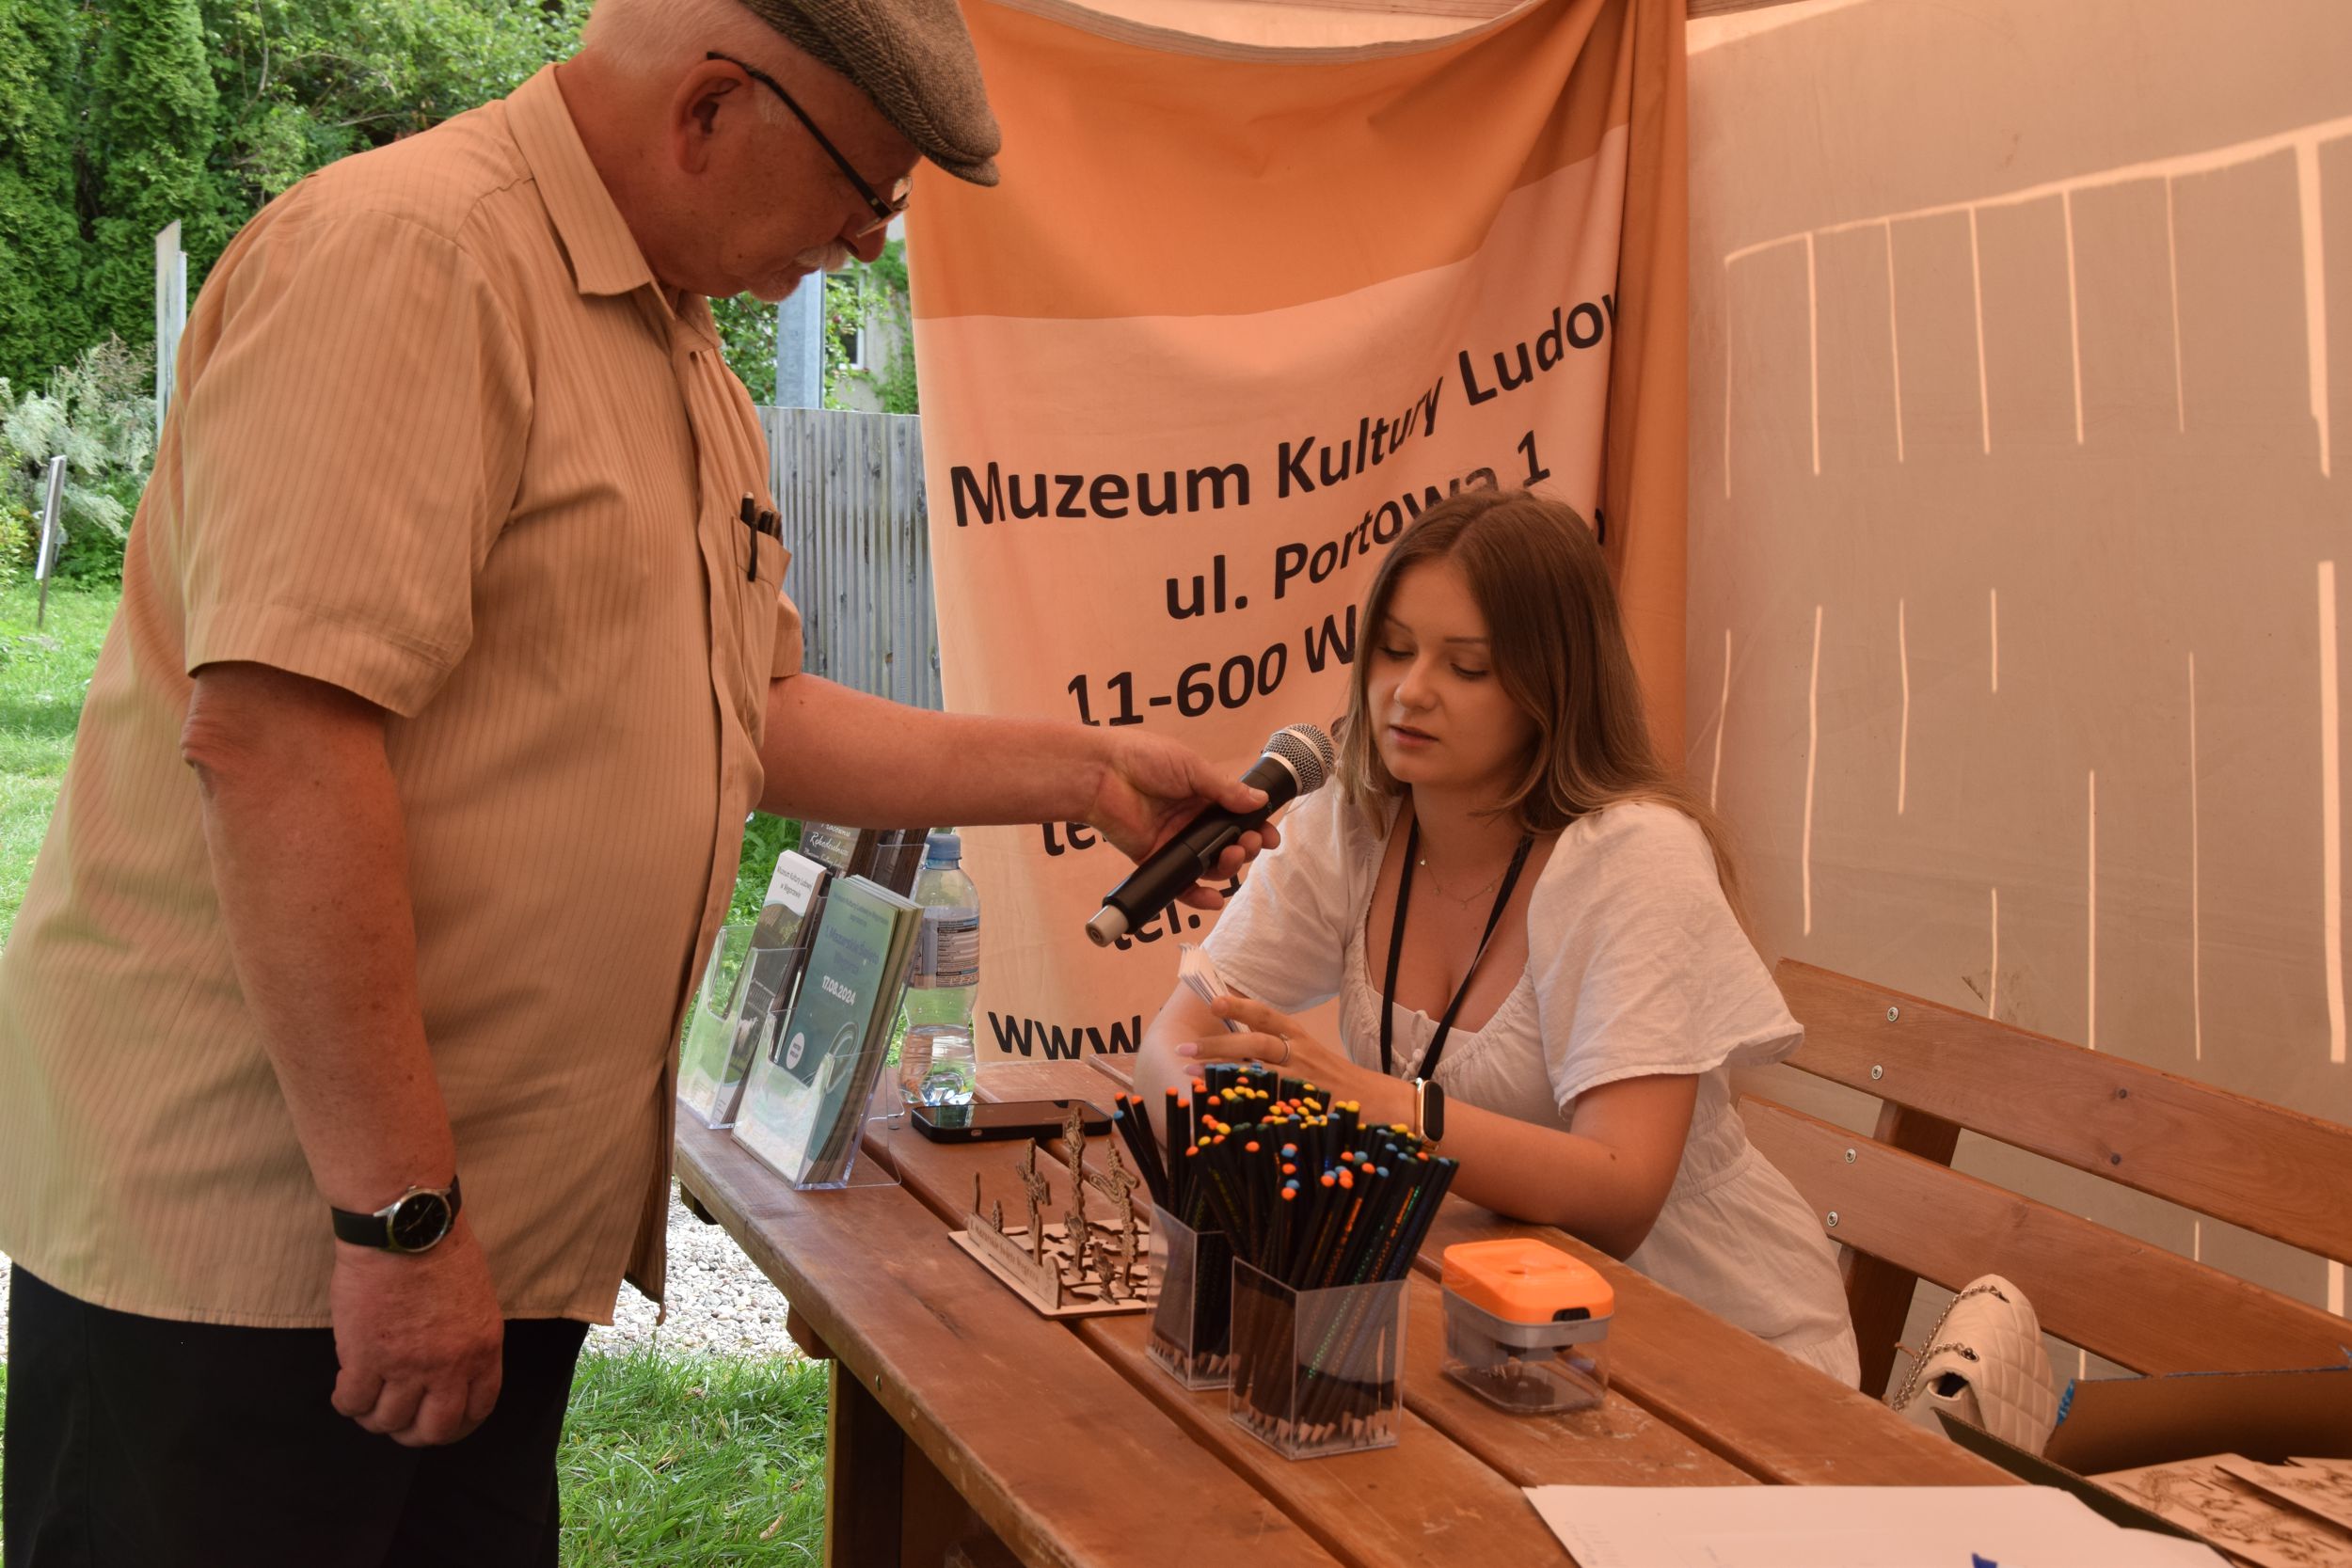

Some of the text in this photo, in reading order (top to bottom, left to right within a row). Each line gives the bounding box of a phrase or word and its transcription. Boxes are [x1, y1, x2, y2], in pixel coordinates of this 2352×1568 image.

[950, 461, 1250, 528] Muzeum
[1278, 375, 1444, 499] Kultury
[1166, 554, 1248, 620] ul.
[1517, 429, 1551, 489] 1
[1067, 604, 1357, 727] 11-600 W
[821, 974, 857, 1006] 17.08.2024
